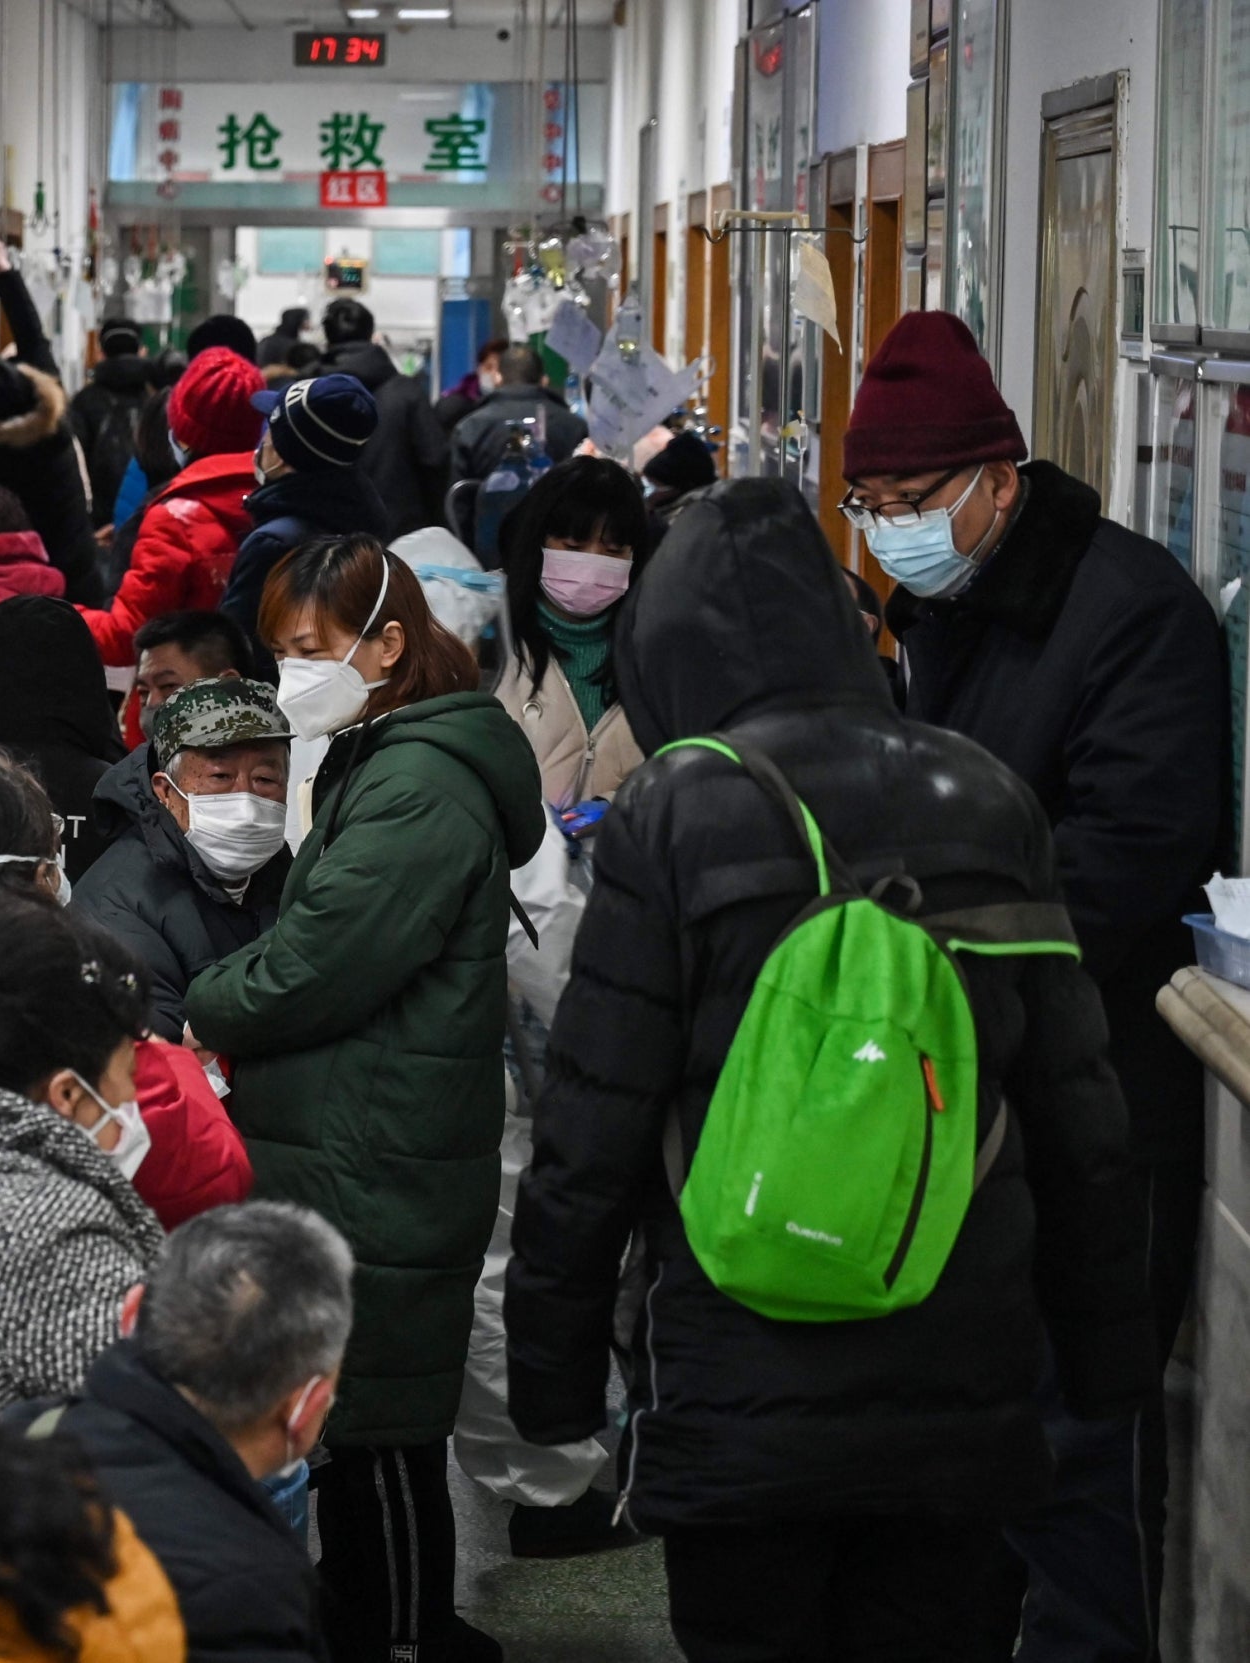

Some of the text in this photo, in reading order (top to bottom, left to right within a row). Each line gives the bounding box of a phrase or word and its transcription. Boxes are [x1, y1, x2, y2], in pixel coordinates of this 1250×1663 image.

[217, 111, 488, 171] 抢救室
[326, 177, 380, 201] 红区
